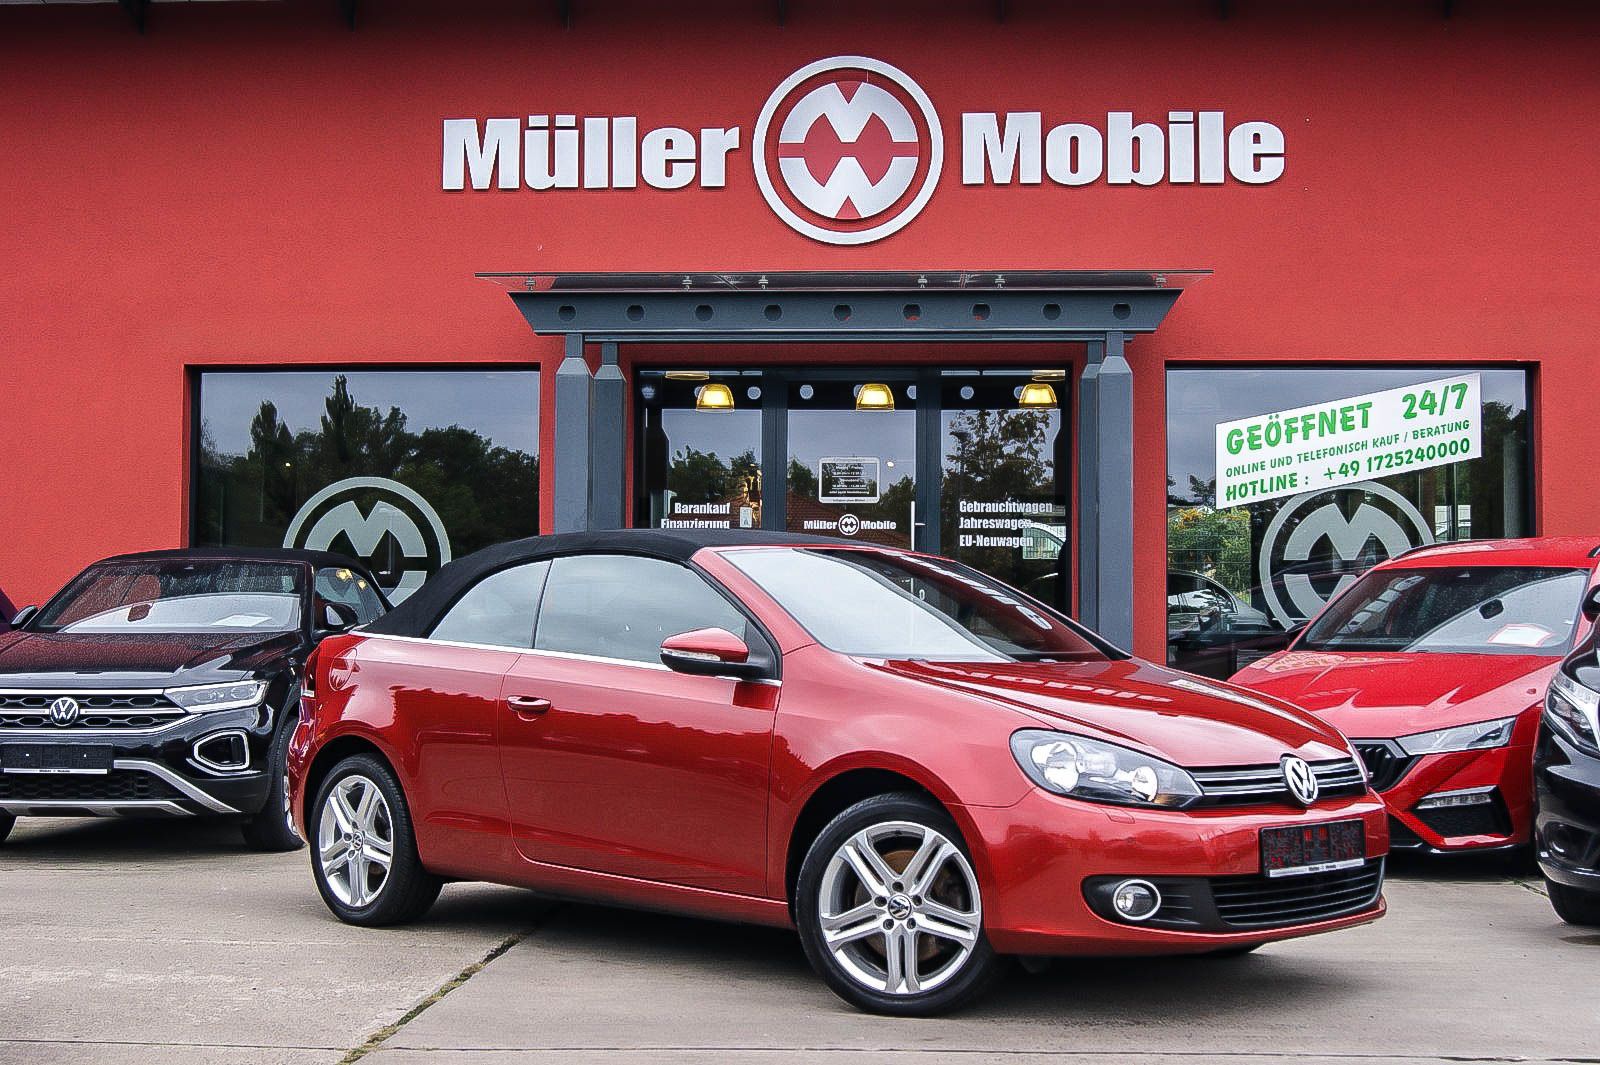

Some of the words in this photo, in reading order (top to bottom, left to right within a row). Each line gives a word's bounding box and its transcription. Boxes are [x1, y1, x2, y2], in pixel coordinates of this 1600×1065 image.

[442, 114, 741, 192] Müller
[961, 110, 1286, 187] Mobile
[1226, 402, 1373, 455] GEÖFFNET
[1401, 382, 1468, 420] 24/7
[1225, 460, 1266, 478] ONLINE
[1270, 455, 1293, 469] UND
[1297, 438, 1368, 464] TELEFONISCH
[1372, 433, 1400, 449] KAUF
[1412, 419, 1470, 440] BERATUNG
[1225, 472, 1298, 501] HOTLINE
[1323, 460, 1360, 481] +49
[1366, 437, 1470, 473] 1725240000
[674, 502, 731, 514] Barankauf
[959, 500, 1053, 513] Gebrauchtwagen
[803, 519, 838, 530] Müller
[860, 520, 897, 530] Mobile
[958, 516, 1032, 530] Jahreswagen
[959, 534, 1034, 549] EU-Neuwagen
